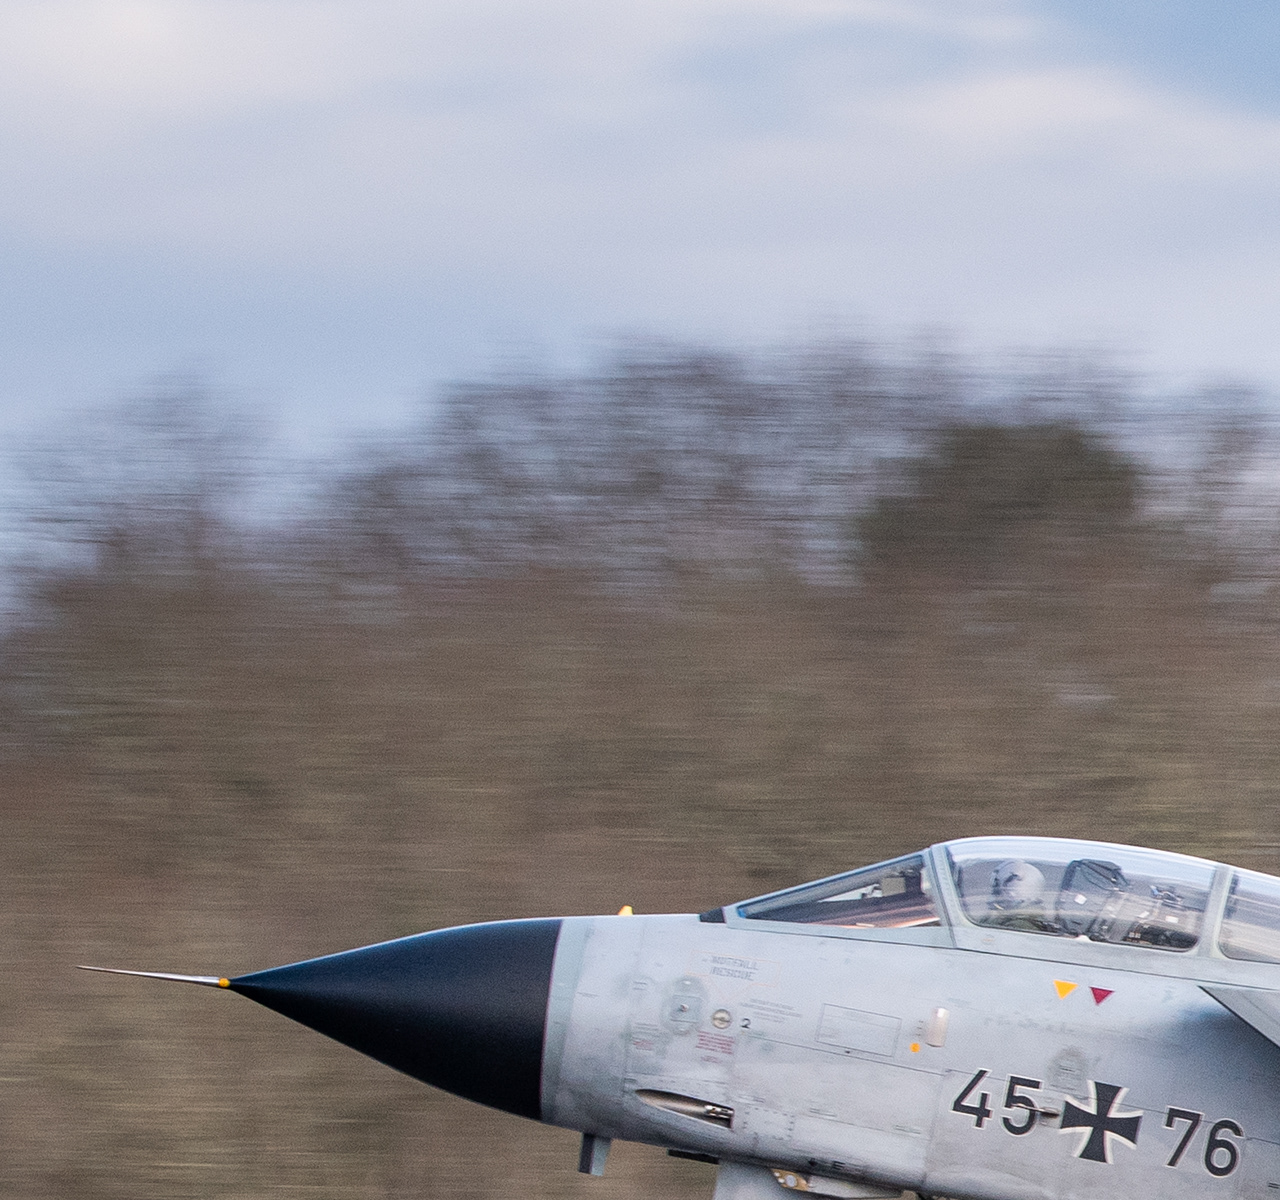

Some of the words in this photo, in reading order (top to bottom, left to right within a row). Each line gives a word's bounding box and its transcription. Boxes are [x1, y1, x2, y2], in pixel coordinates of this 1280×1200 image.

[740, 1017, 752, 1029] 2
[951, 1067, 1043, 1136] 45
[1163, 1105, 1245, 1178] 76
